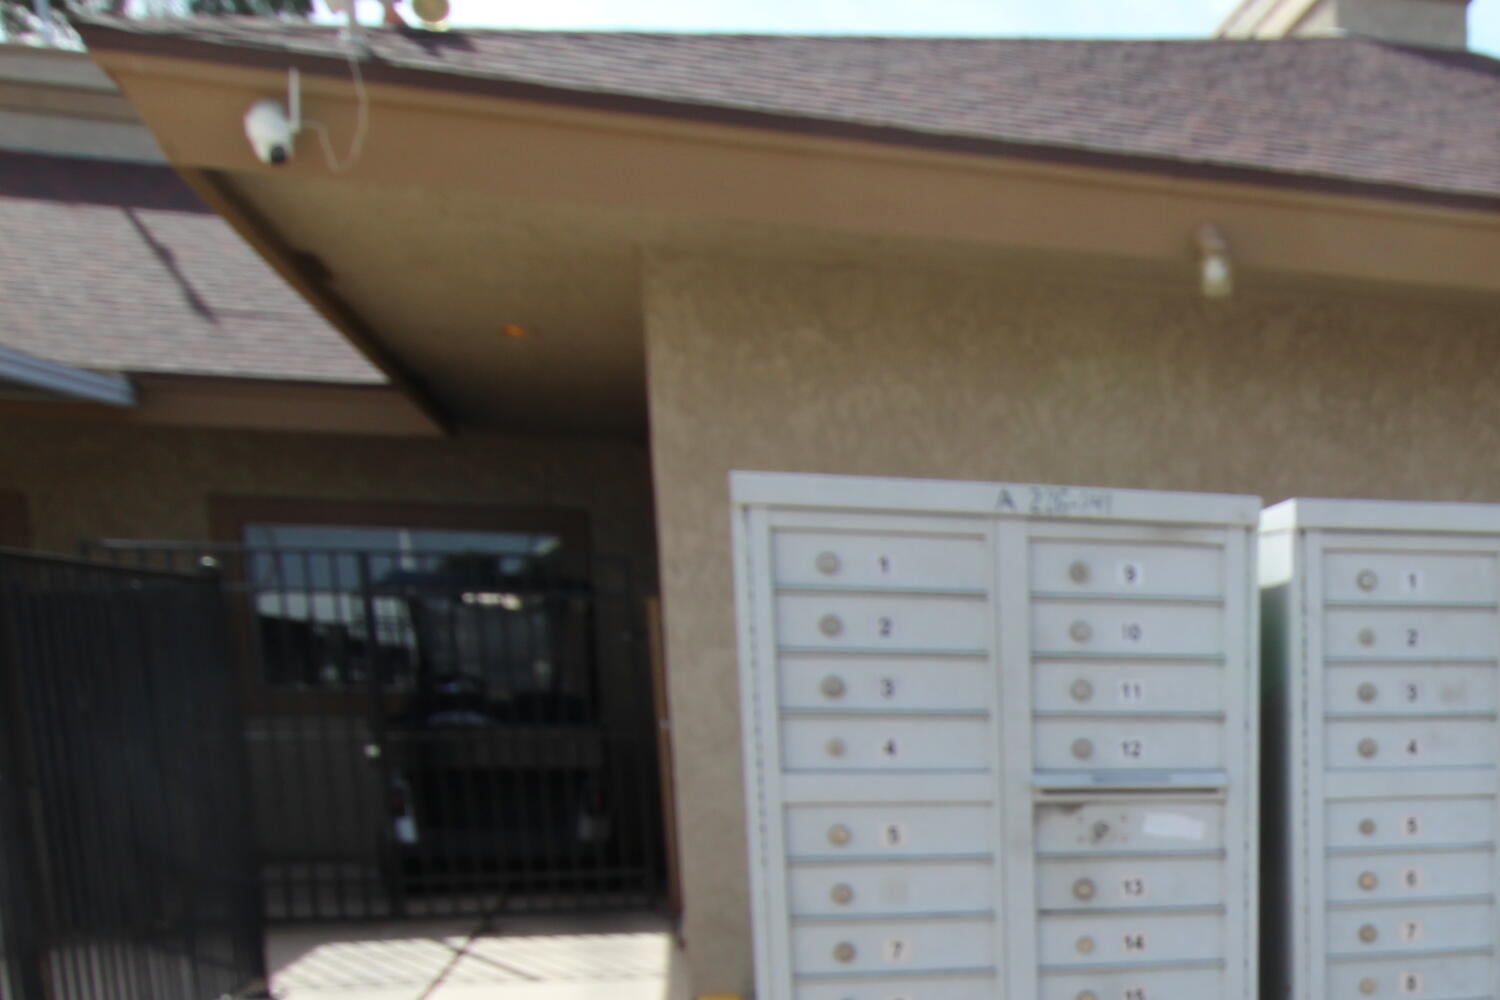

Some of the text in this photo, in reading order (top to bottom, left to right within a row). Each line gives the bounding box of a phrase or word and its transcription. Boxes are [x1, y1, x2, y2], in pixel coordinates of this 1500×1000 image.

[993, 485, 1017, 511] A
[1121, 623, 1141, 641] 10
[1121, 683, 1141, 699] 11
[1121, 740, 1141, 757] 12
[1123, 879, 1143, 895] 13
[1123, 935, 1144, 951] 14
